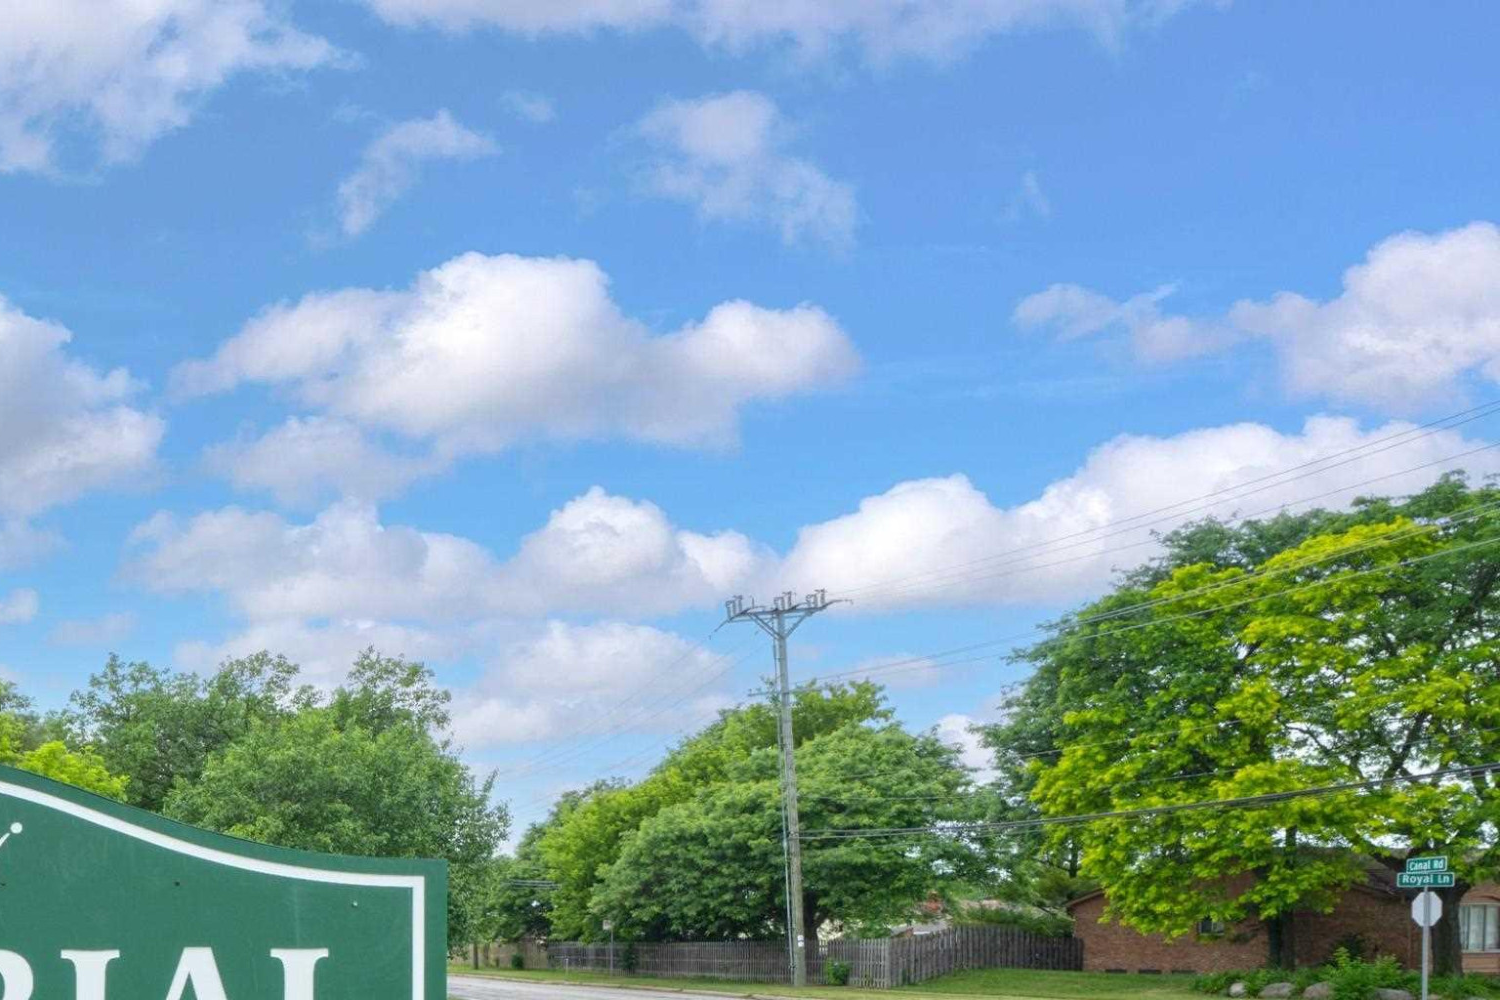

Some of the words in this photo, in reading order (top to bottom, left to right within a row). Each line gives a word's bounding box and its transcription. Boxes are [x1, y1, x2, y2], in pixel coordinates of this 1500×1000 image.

[1409, 859, 1431, 871] Canal
[1433, 859, 1444, 869] Rd
[1402, 874, 1434, 886] Royal
[1438, 875, 1450, 883] Ln
